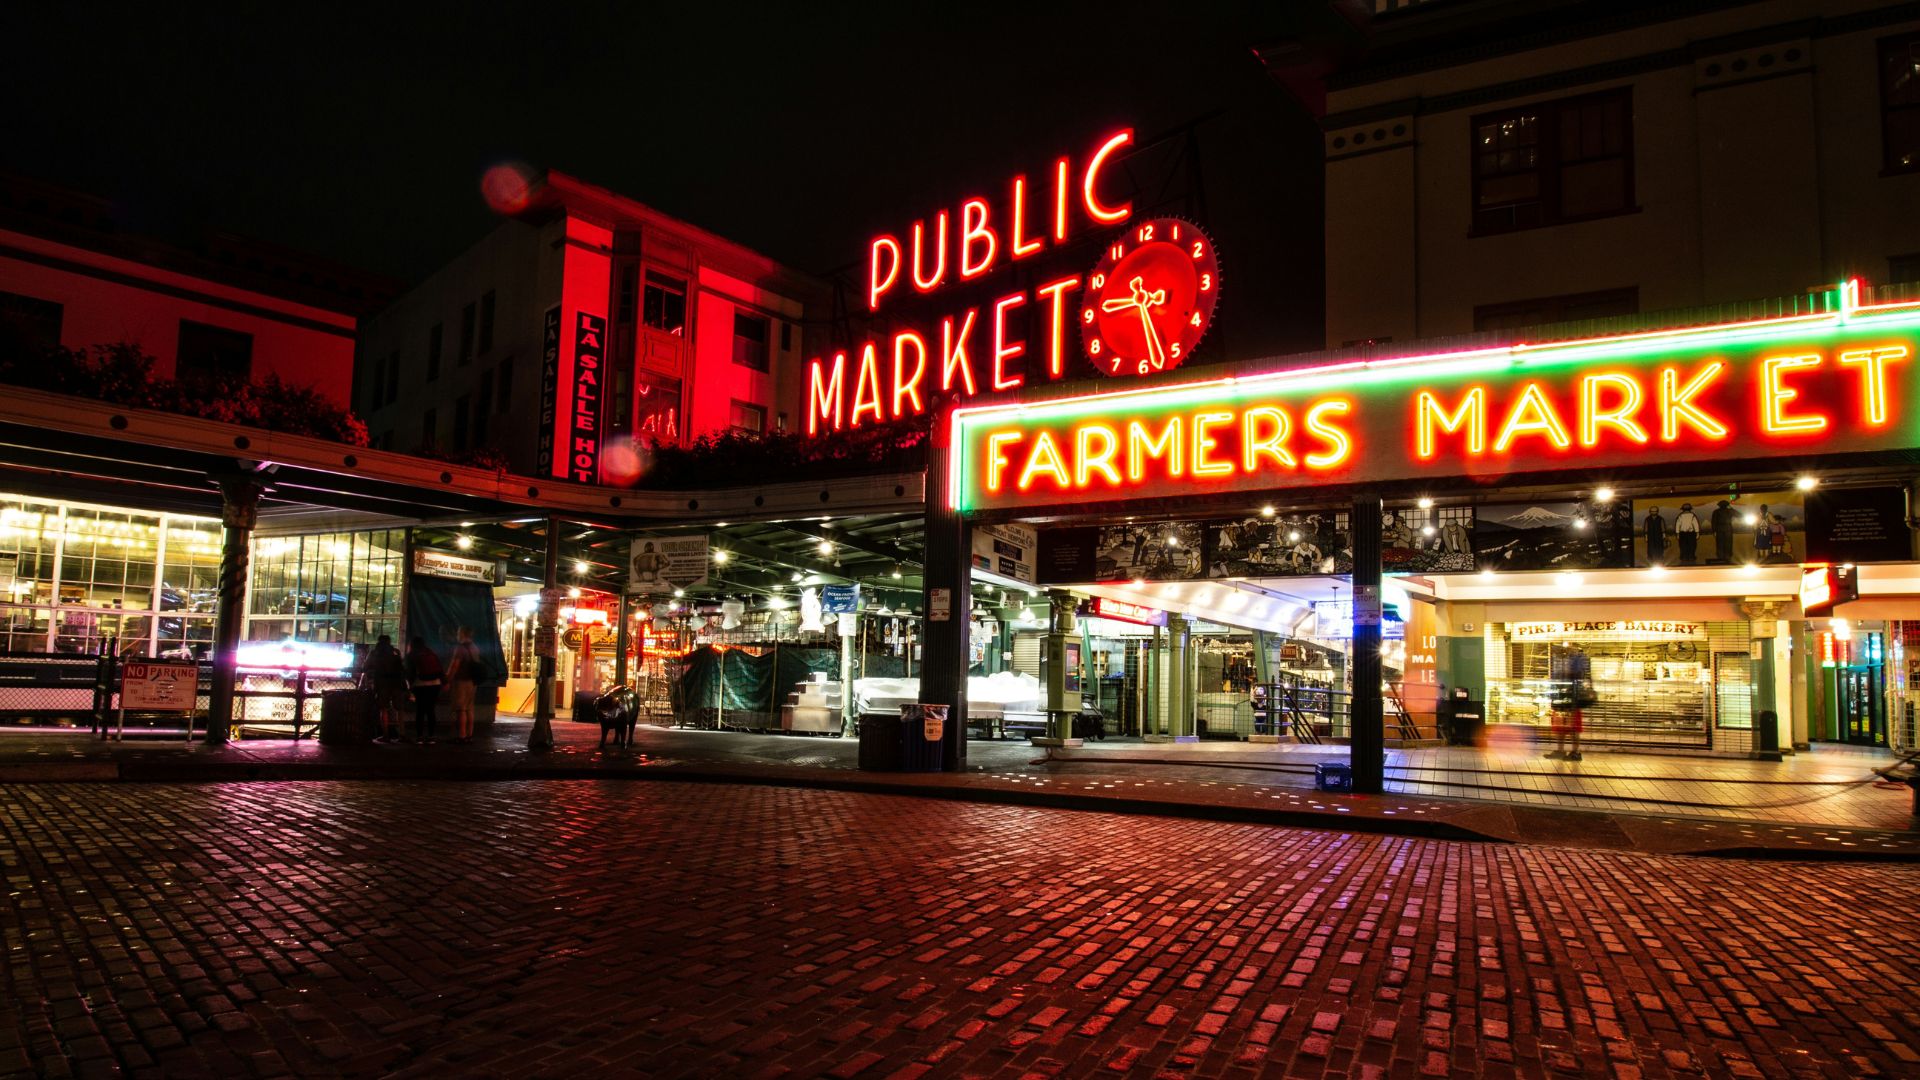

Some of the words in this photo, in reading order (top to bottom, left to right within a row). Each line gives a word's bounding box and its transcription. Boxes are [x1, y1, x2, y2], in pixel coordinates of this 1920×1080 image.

[867, 128, 1134, 311] PUBLIC
[1139, 225, 1154, 242] 12
[1172, 225, 1179, 240] 1
[1111, 244, 1123, 261] 11
[1192, 242, 1203, 258] 2
[1091, 273, 1105, 290] 10
[1200, 274, 1211, 291] 3
[1084, 309, 1095, 324] 9
[1190, 311, 1202, 327] 4
[579, 315, 600, 349] LA
[1090, 338, 1101, 354] 8
[1170, 342, 1181, 358] 5
[807, 275, 1080, 437] MARKET
[1111, 357, 1121, 372] 7
[1138, 359, 1149, 374] 6
[576, 354, 598, 432] SALLE
[984, 396, 1355, 492] FARMERS
[1414, 343, 1911, 461] MARKET
[574, 437, 596, 483] HOT
[1517, 623, 1557, 636] PIKE
[1563, 621, 1617, 632] PLACE
[1623, 619, 1700, 635] BAKERY
[127, 665, 145, 677] NO
[150, 667, 195, 678] PARKING
